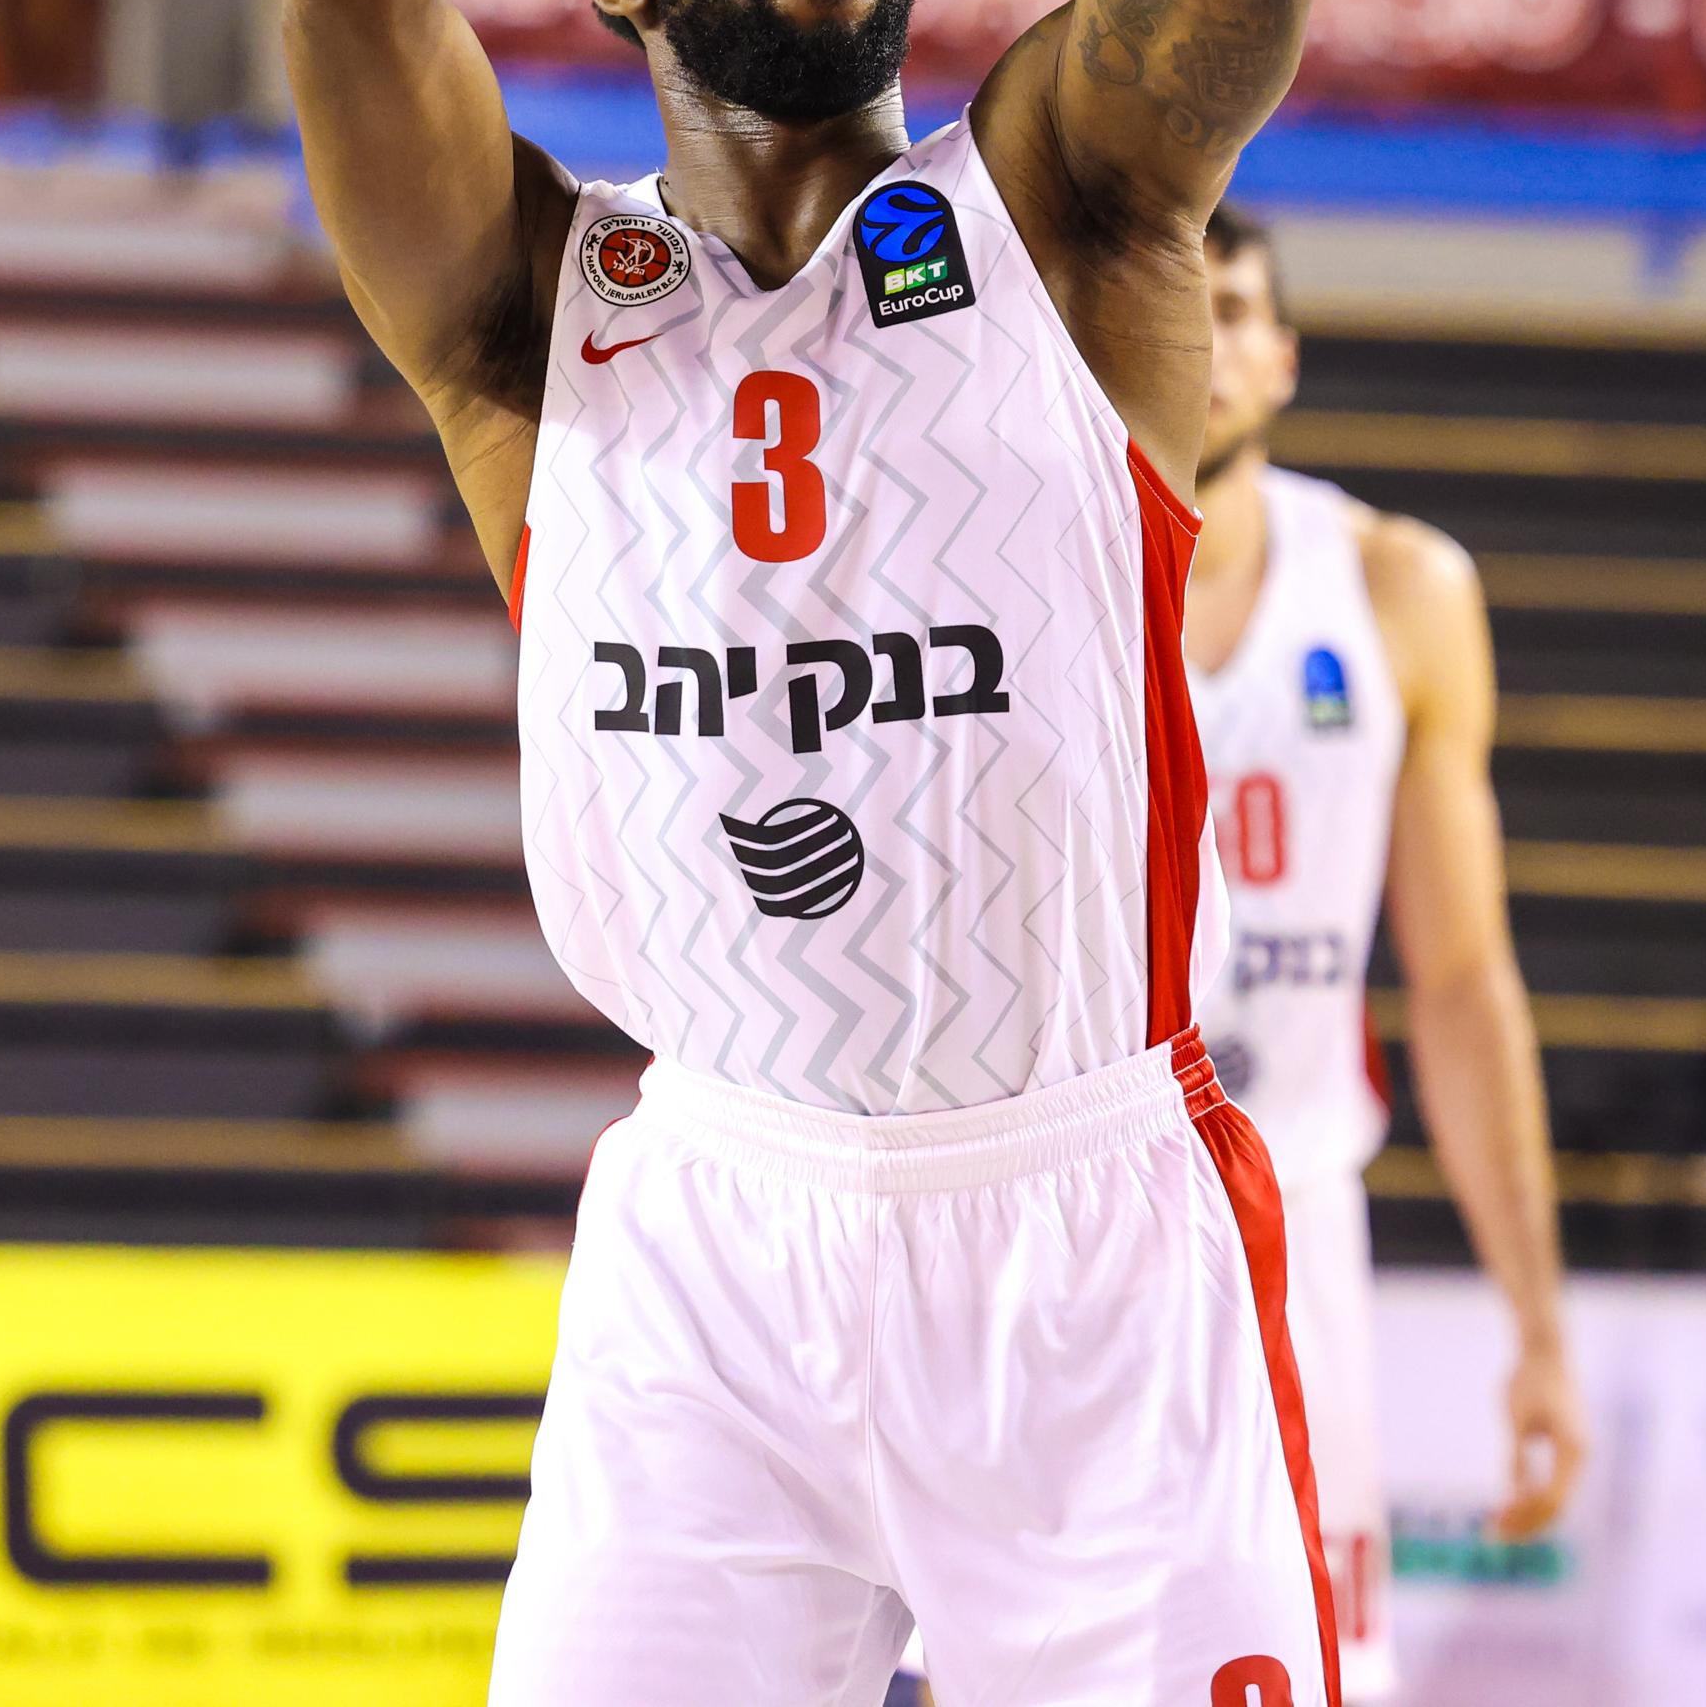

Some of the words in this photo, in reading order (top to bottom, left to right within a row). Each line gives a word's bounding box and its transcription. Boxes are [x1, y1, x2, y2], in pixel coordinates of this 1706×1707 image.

[585, 253, 607, 293] HAPOEL
[604, 285, 662, 302] JERUSALEM
[878, 284, 964, 317] EuroCup
[885, 260, 947, 293] BKT
[730, 370, 827, 564] 3
[593, 637, 758, 739] יהב
[784, 622, 1011, 755] בנק
